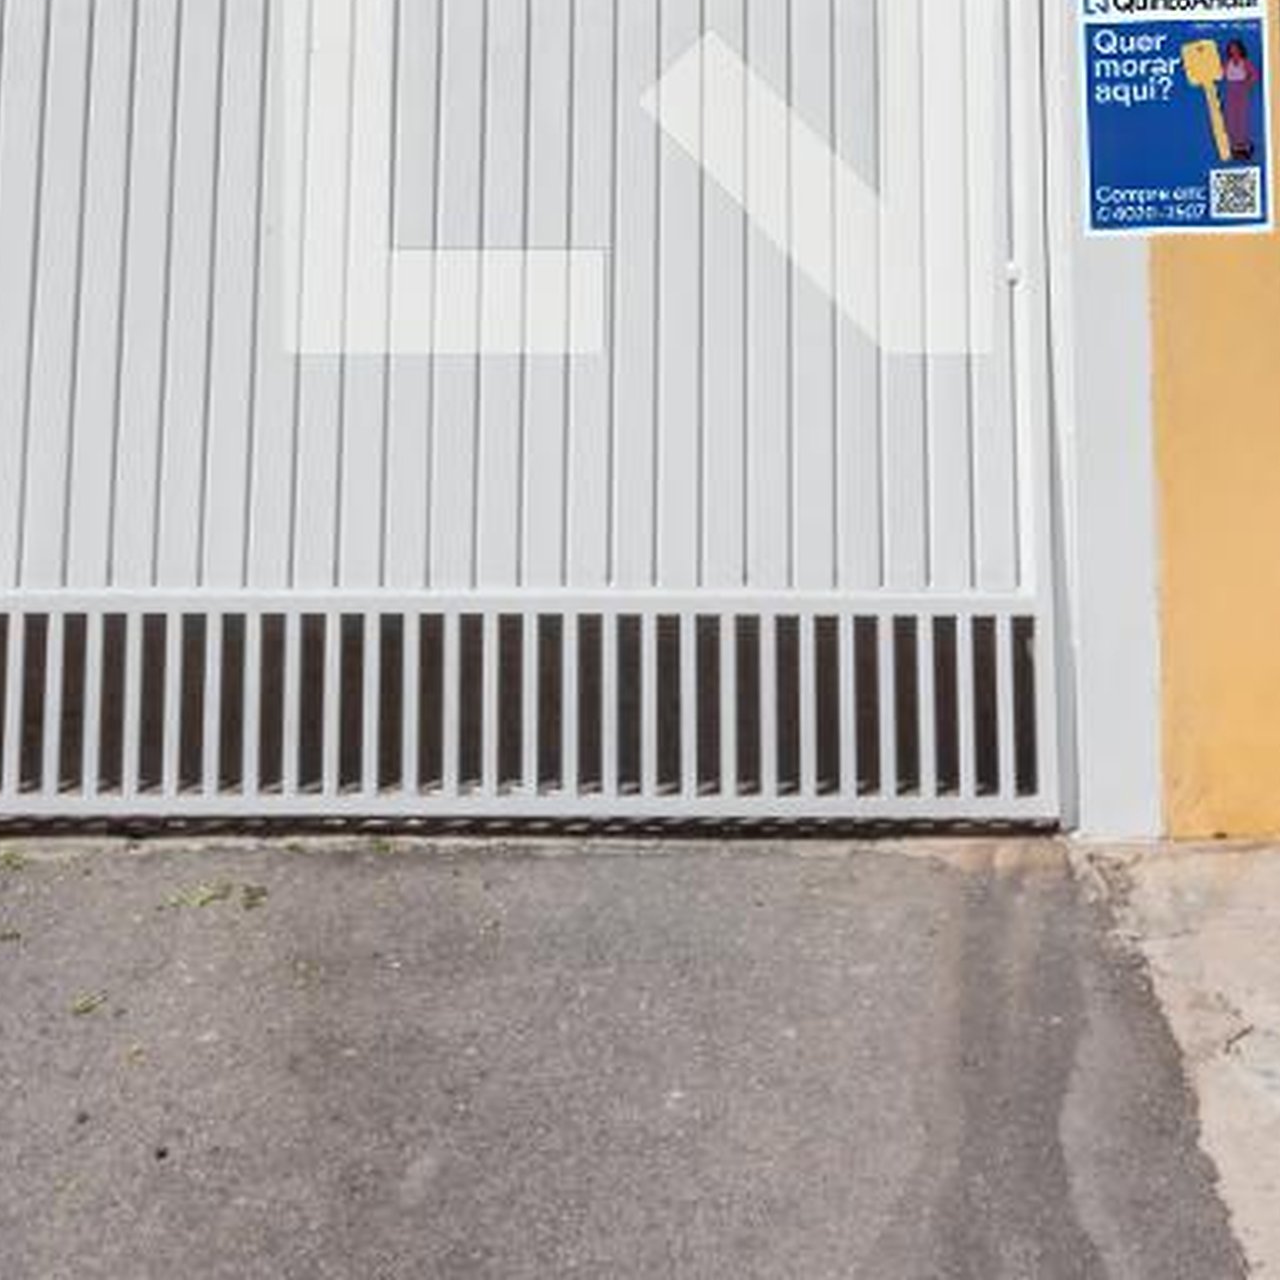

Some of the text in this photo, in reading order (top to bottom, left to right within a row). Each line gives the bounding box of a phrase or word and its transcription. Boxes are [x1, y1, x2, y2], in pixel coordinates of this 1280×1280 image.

[1093, 29, 1167, 54] Quer
[1096, 58, 1180, 77] morar
[1095, 76, 1174, 107] aqui?
